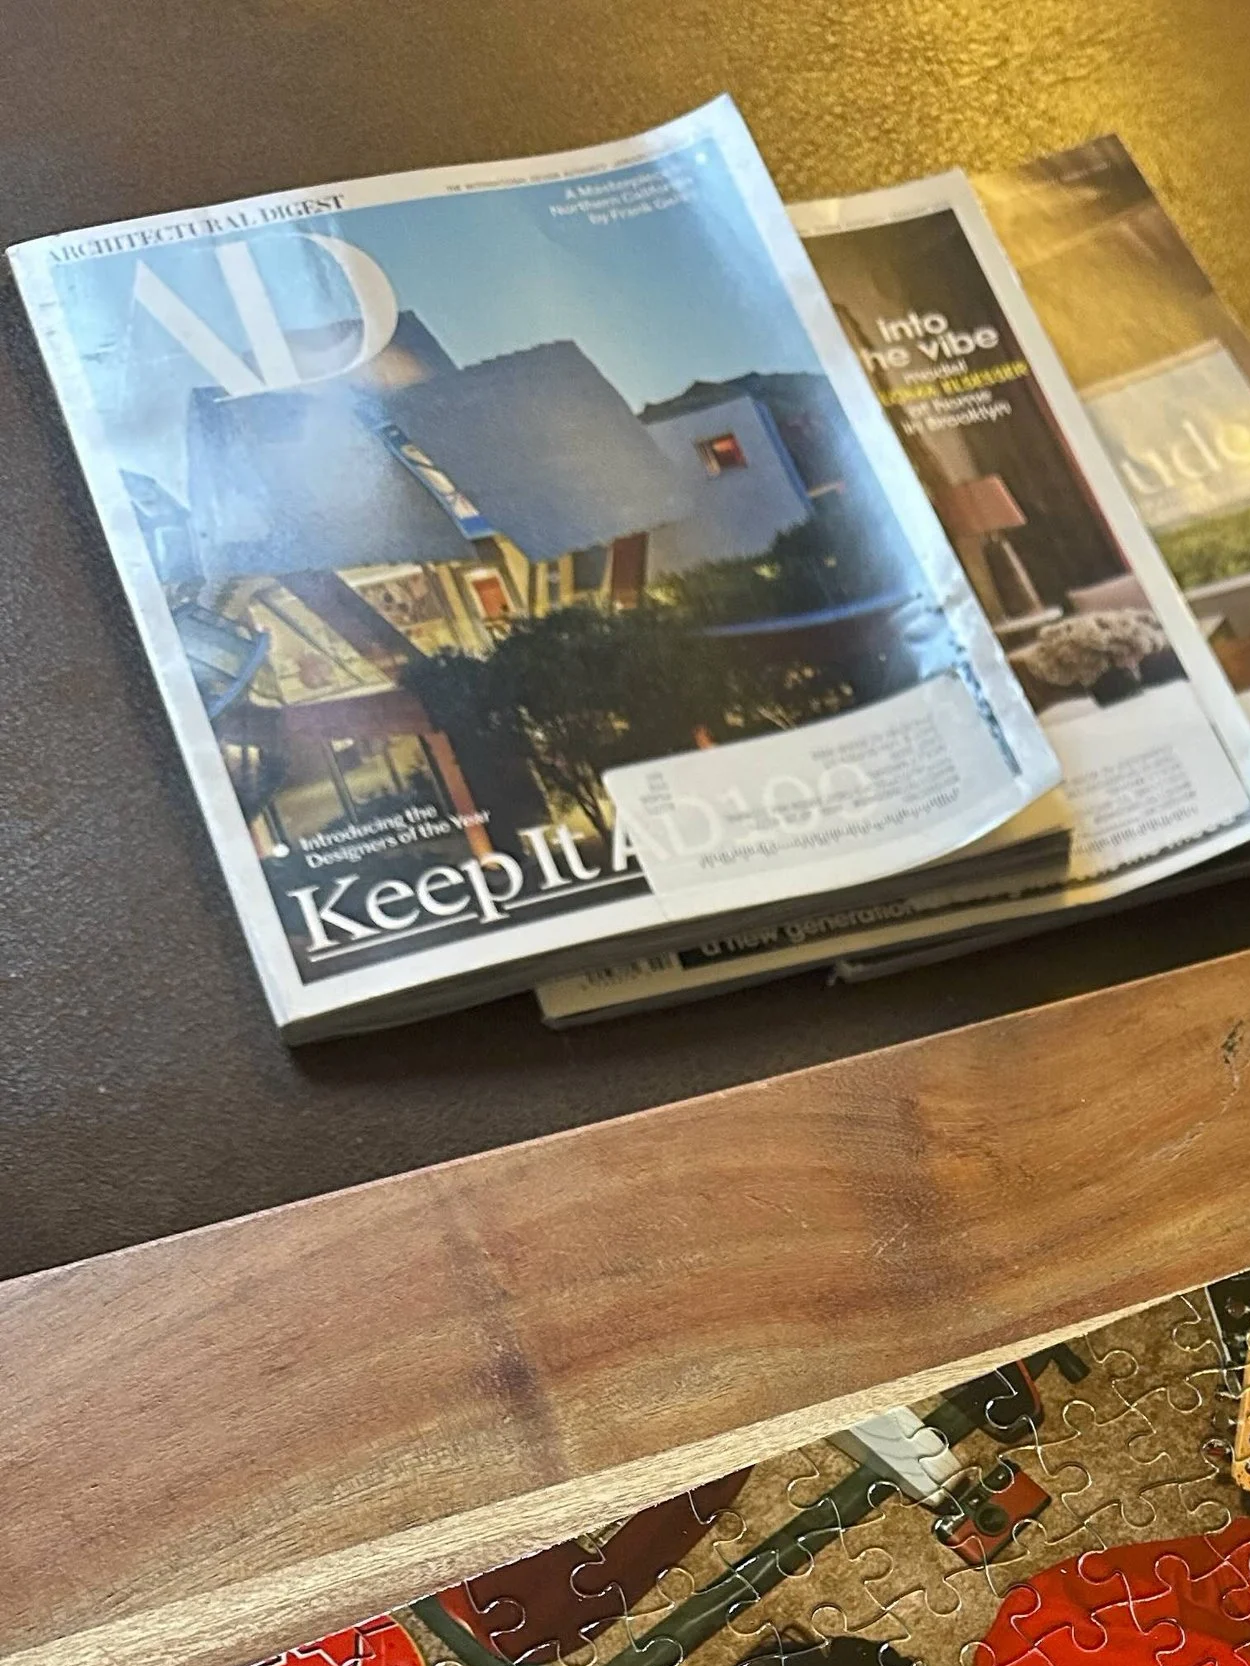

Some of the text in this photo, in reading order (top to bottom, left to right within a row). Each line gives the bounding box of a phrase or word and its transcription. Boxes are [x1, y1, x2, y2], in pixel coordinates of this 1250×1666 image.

[47, 194, 345, 264] ARCHITECTURAL DIGEST
[860, 325, 1000, 372] he vibe
[876, 310, 949, 343] into
[299, 804, 438, 852] Introducing the
[304, 808, 491, 869] Designers of the Year
[287, 852, 524, 953] Keep
[518, 824, 601, 890] It
